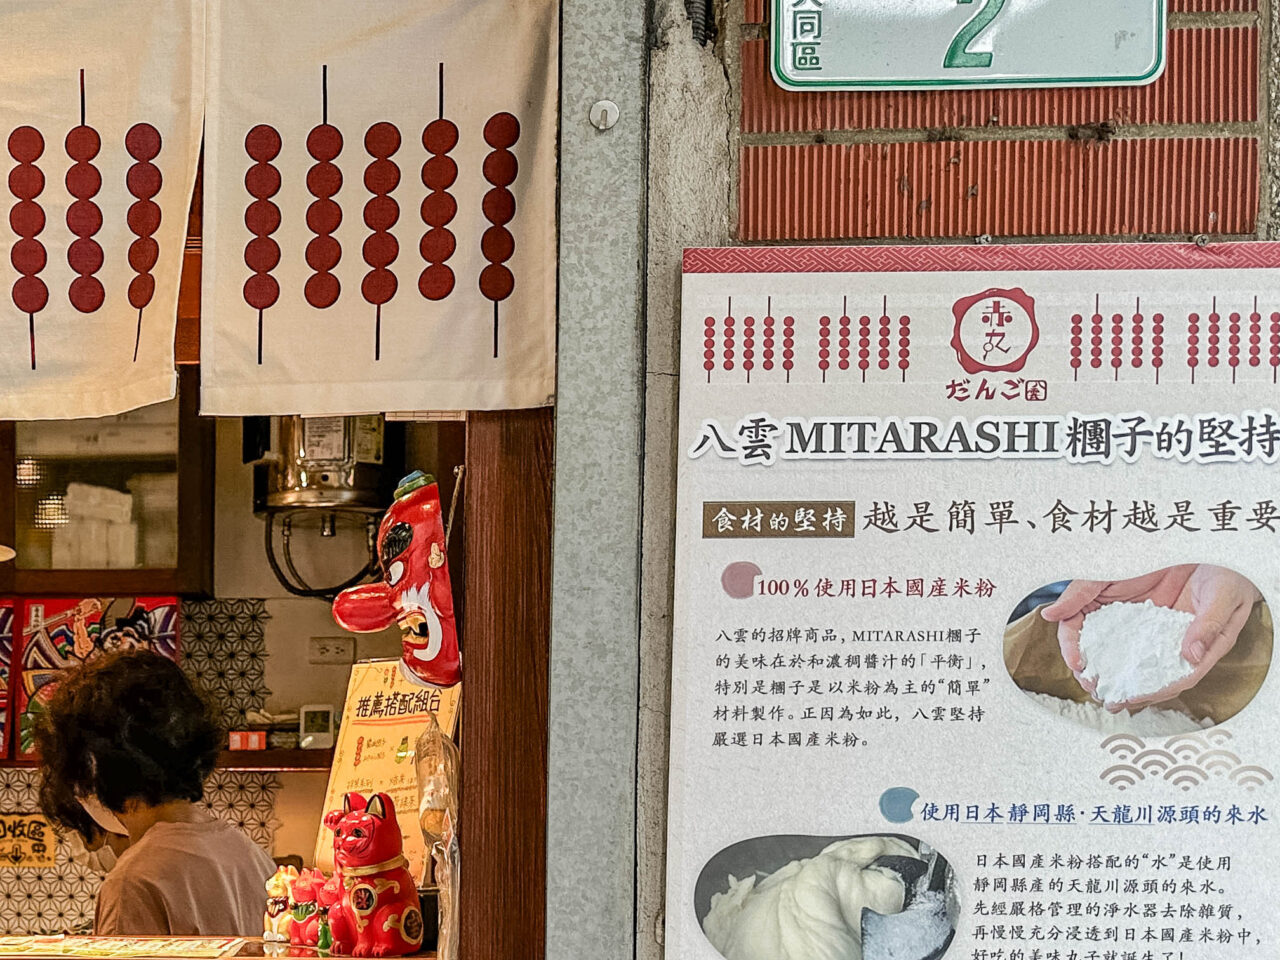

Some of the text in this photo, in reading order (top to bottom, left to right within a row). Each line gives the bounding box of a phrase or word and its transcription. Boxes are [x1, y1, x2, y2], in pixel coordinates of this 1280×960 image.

[980, 300, 1016, 362] 赤丸
[711, 506, 848, 533] 食材的堅持
[862, 499, 1280, 535] 越是簡單、食材越是重要
